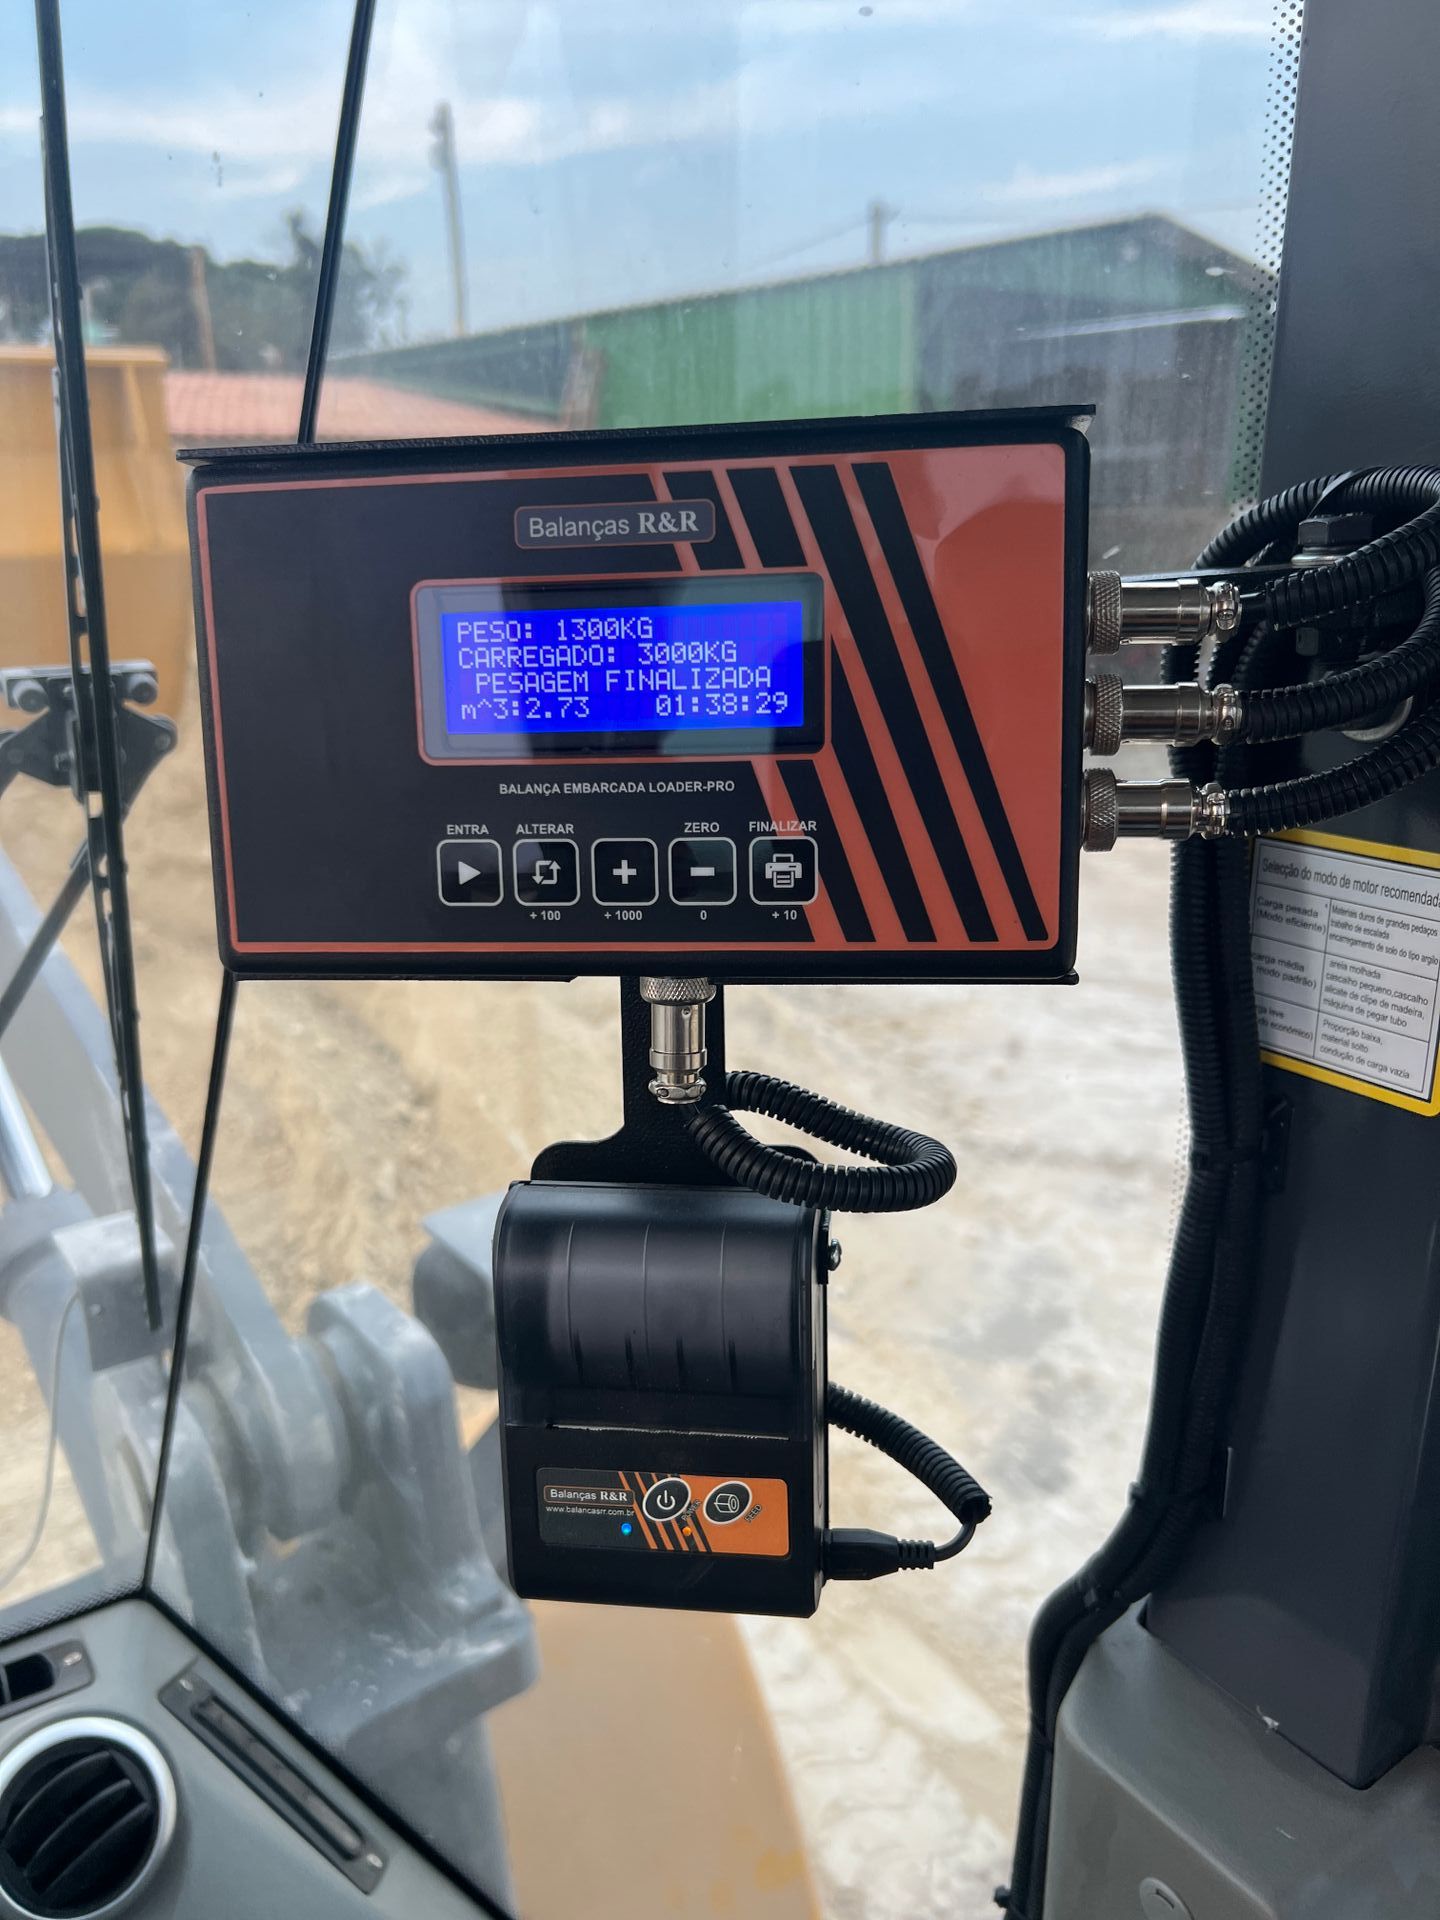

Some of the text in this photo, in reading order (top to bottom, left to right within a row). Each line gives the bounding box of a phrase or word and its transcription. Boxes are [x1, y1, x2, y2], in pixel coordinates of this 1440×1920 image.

[529, 510, 700, 542] Balanças R&R
[457, 617, 653, 644] PESO: 1300KG
[458, 641, 737, 669] CARREGADO: 3000KG
[476, 666, 772, 695] PESAGEM FINALIZADA
[461, 692, 789, 721] m^3:2.73 01:38:29
[499, 780, 735, 797] BALANÇA EMBARCADA LOADER-PRO
[446, 823, 489, 836] ENTRA
[515, 823, 575, 836] ALTERAR
[684, 821, 720, 834] ZERO
[748, 820, 818, 833] FINALIZAR
[1301, 866, 1312, 881] do
[1313, 871, 1338, 887] modo
[1339, 873, 1351, 890] de
[1352, 879, 1379, 895] motor
[1380, 885, 1440, 908] recomendad
[540, 909, 562, 921] 100
[614, 909, 643, 921] 1000
[699, 909, 708, 921] 0
[781, 908, 798, 921] 10
[1376, 915, 1384, 925] de
[1385, 918, 1410, 931] grandes
[1411, 923, 1438, 938] pedaços
[1348, 964, 1381, 980] molhada
[1348, 991, 1359, 1001] de
[1379, 999, 1389, 1009] de
[1355, 1006, 1365, 1017] de
[1366, 1009, 1389, 1024] pegar
[1389, 1015, 1408, 1028] tubo
[1350, 1040, 1369, 1054] solto
[1355, 1055, 1366, 1067] de
[1366, 1059, 1389, 1074] carga
[1389, 1067, 1411, 1080] vazia
[550, 1489, 628, 1502] Balanças R&R
